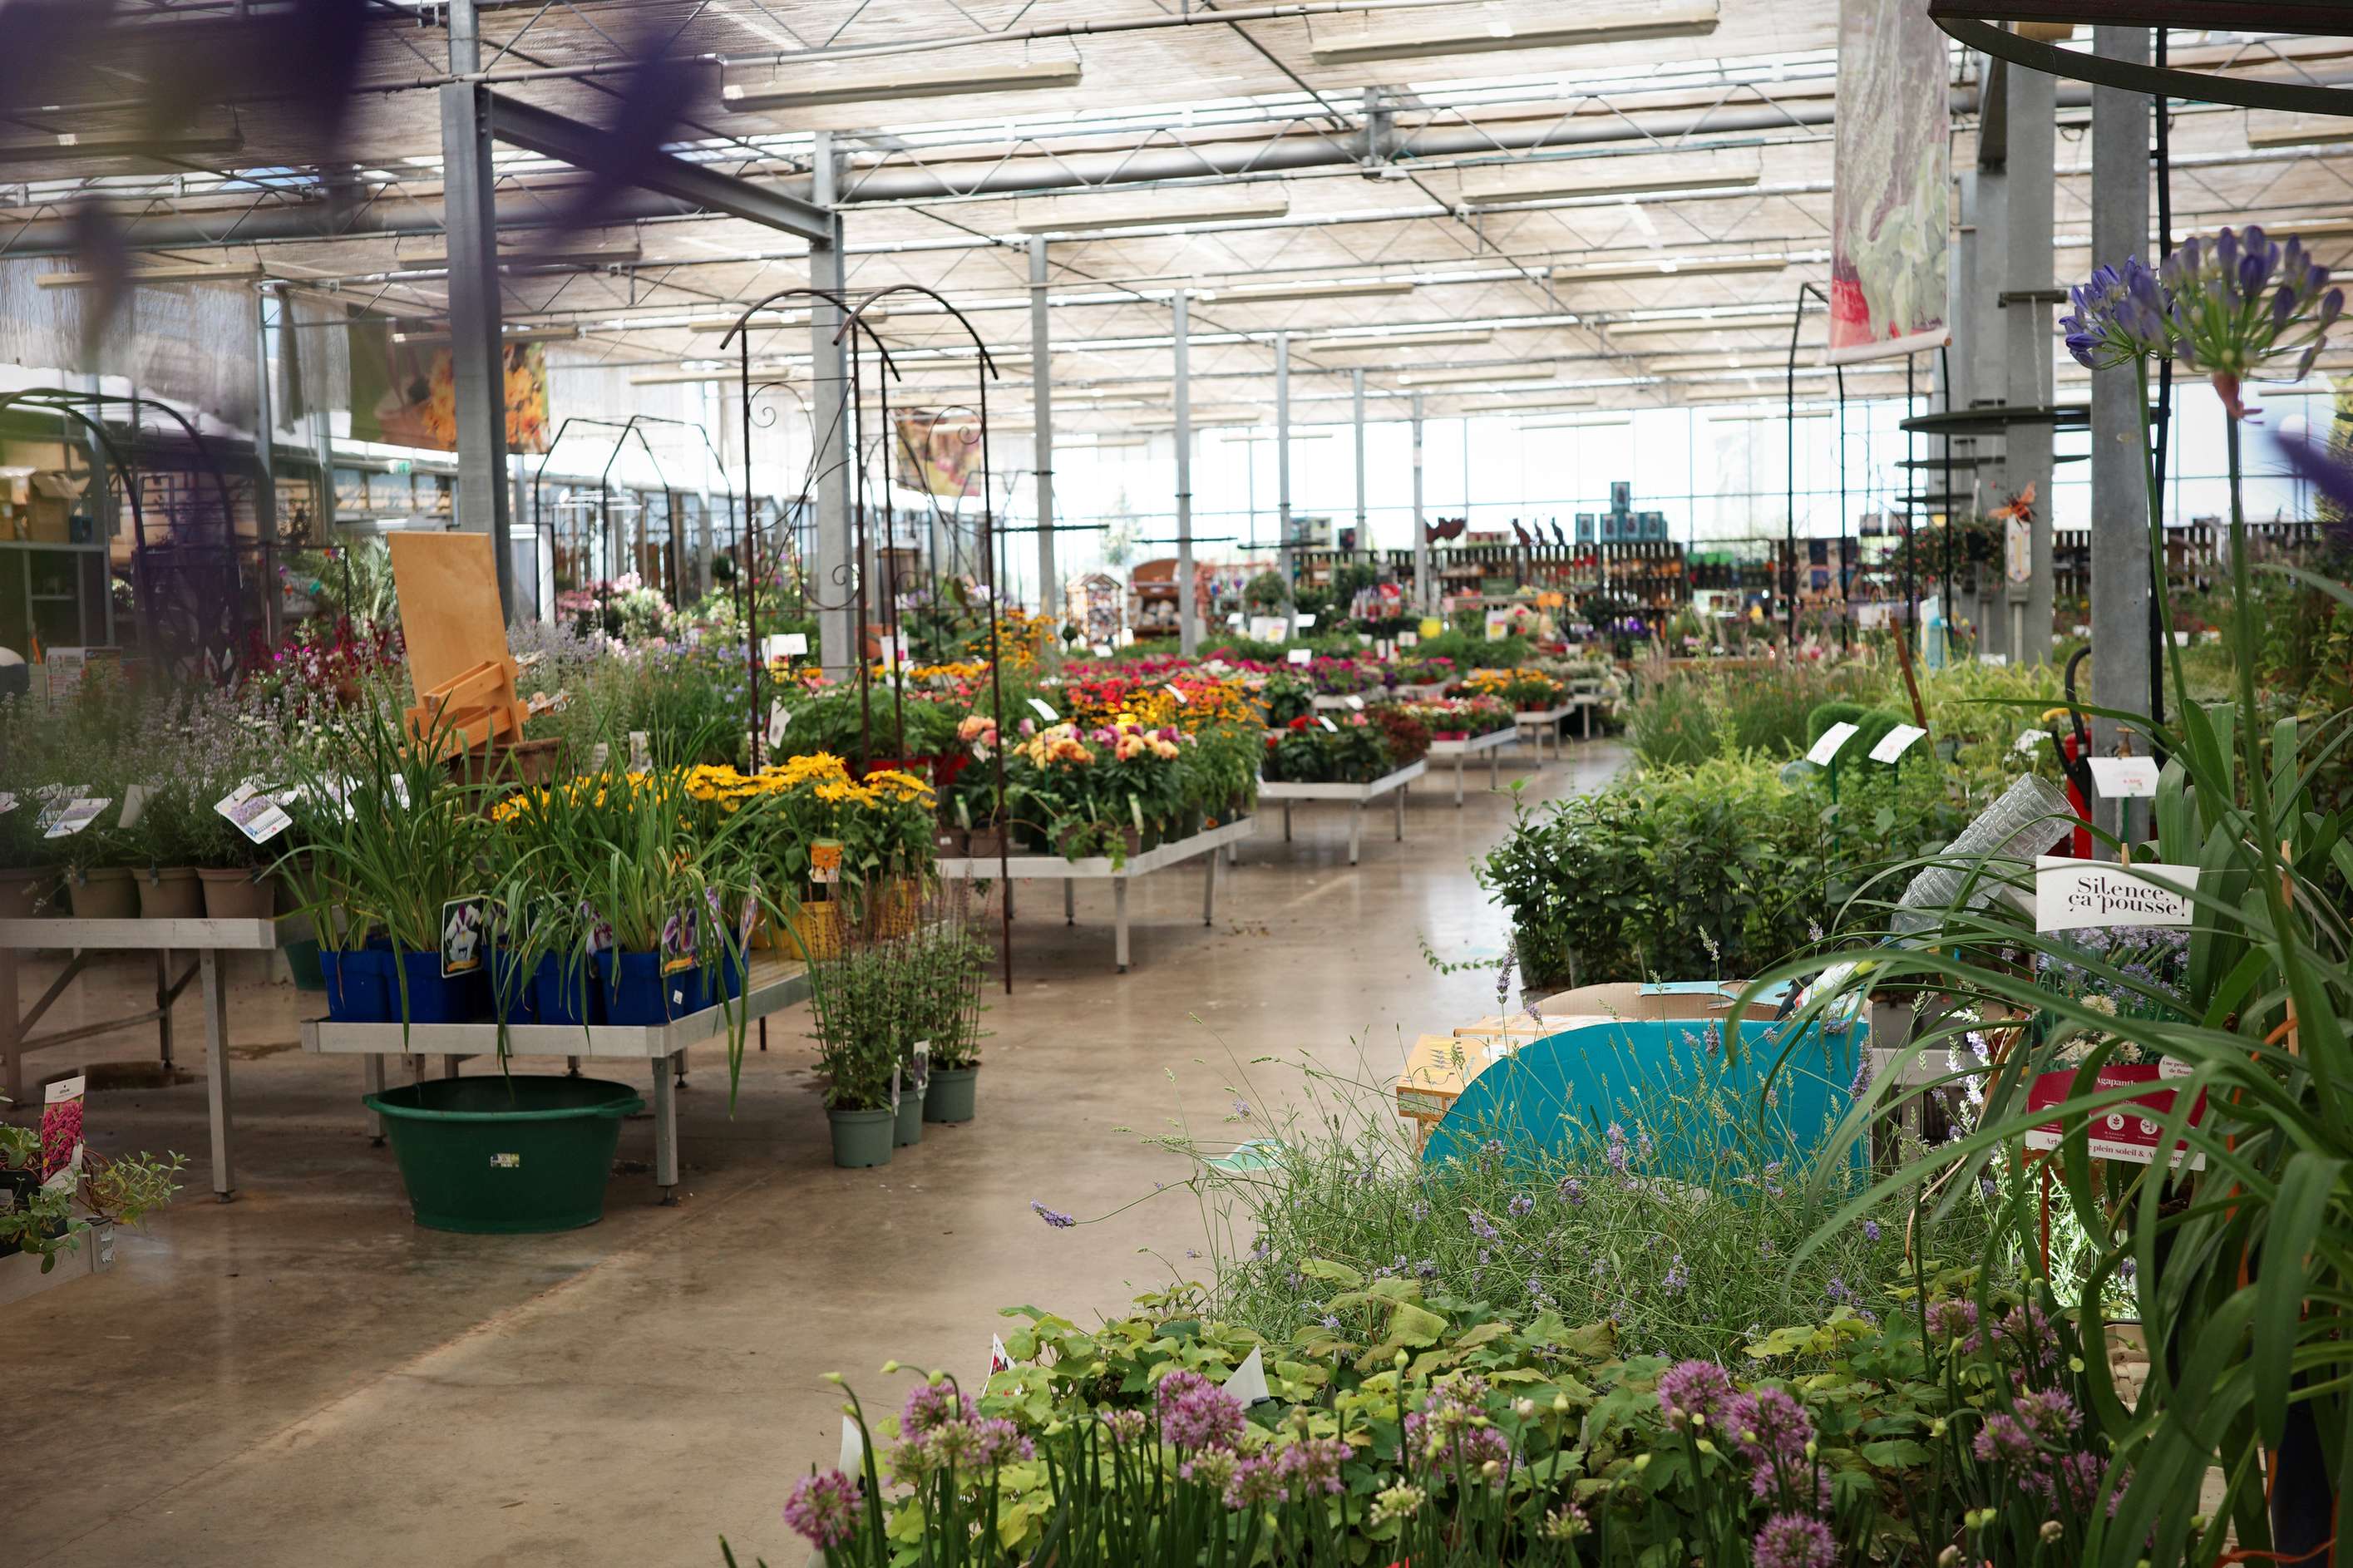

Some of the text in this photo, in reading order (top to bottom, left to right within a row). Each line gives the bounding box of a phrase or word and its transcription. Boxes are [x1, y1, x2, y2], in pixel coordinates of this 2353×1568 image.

[2077, 876, 2170, 903] Silence,
[2068, 894, 2093, 912] ça
[2093, 1144, 2114, 1153] plein
[2115, 1147, 2138, 1156] soleil
